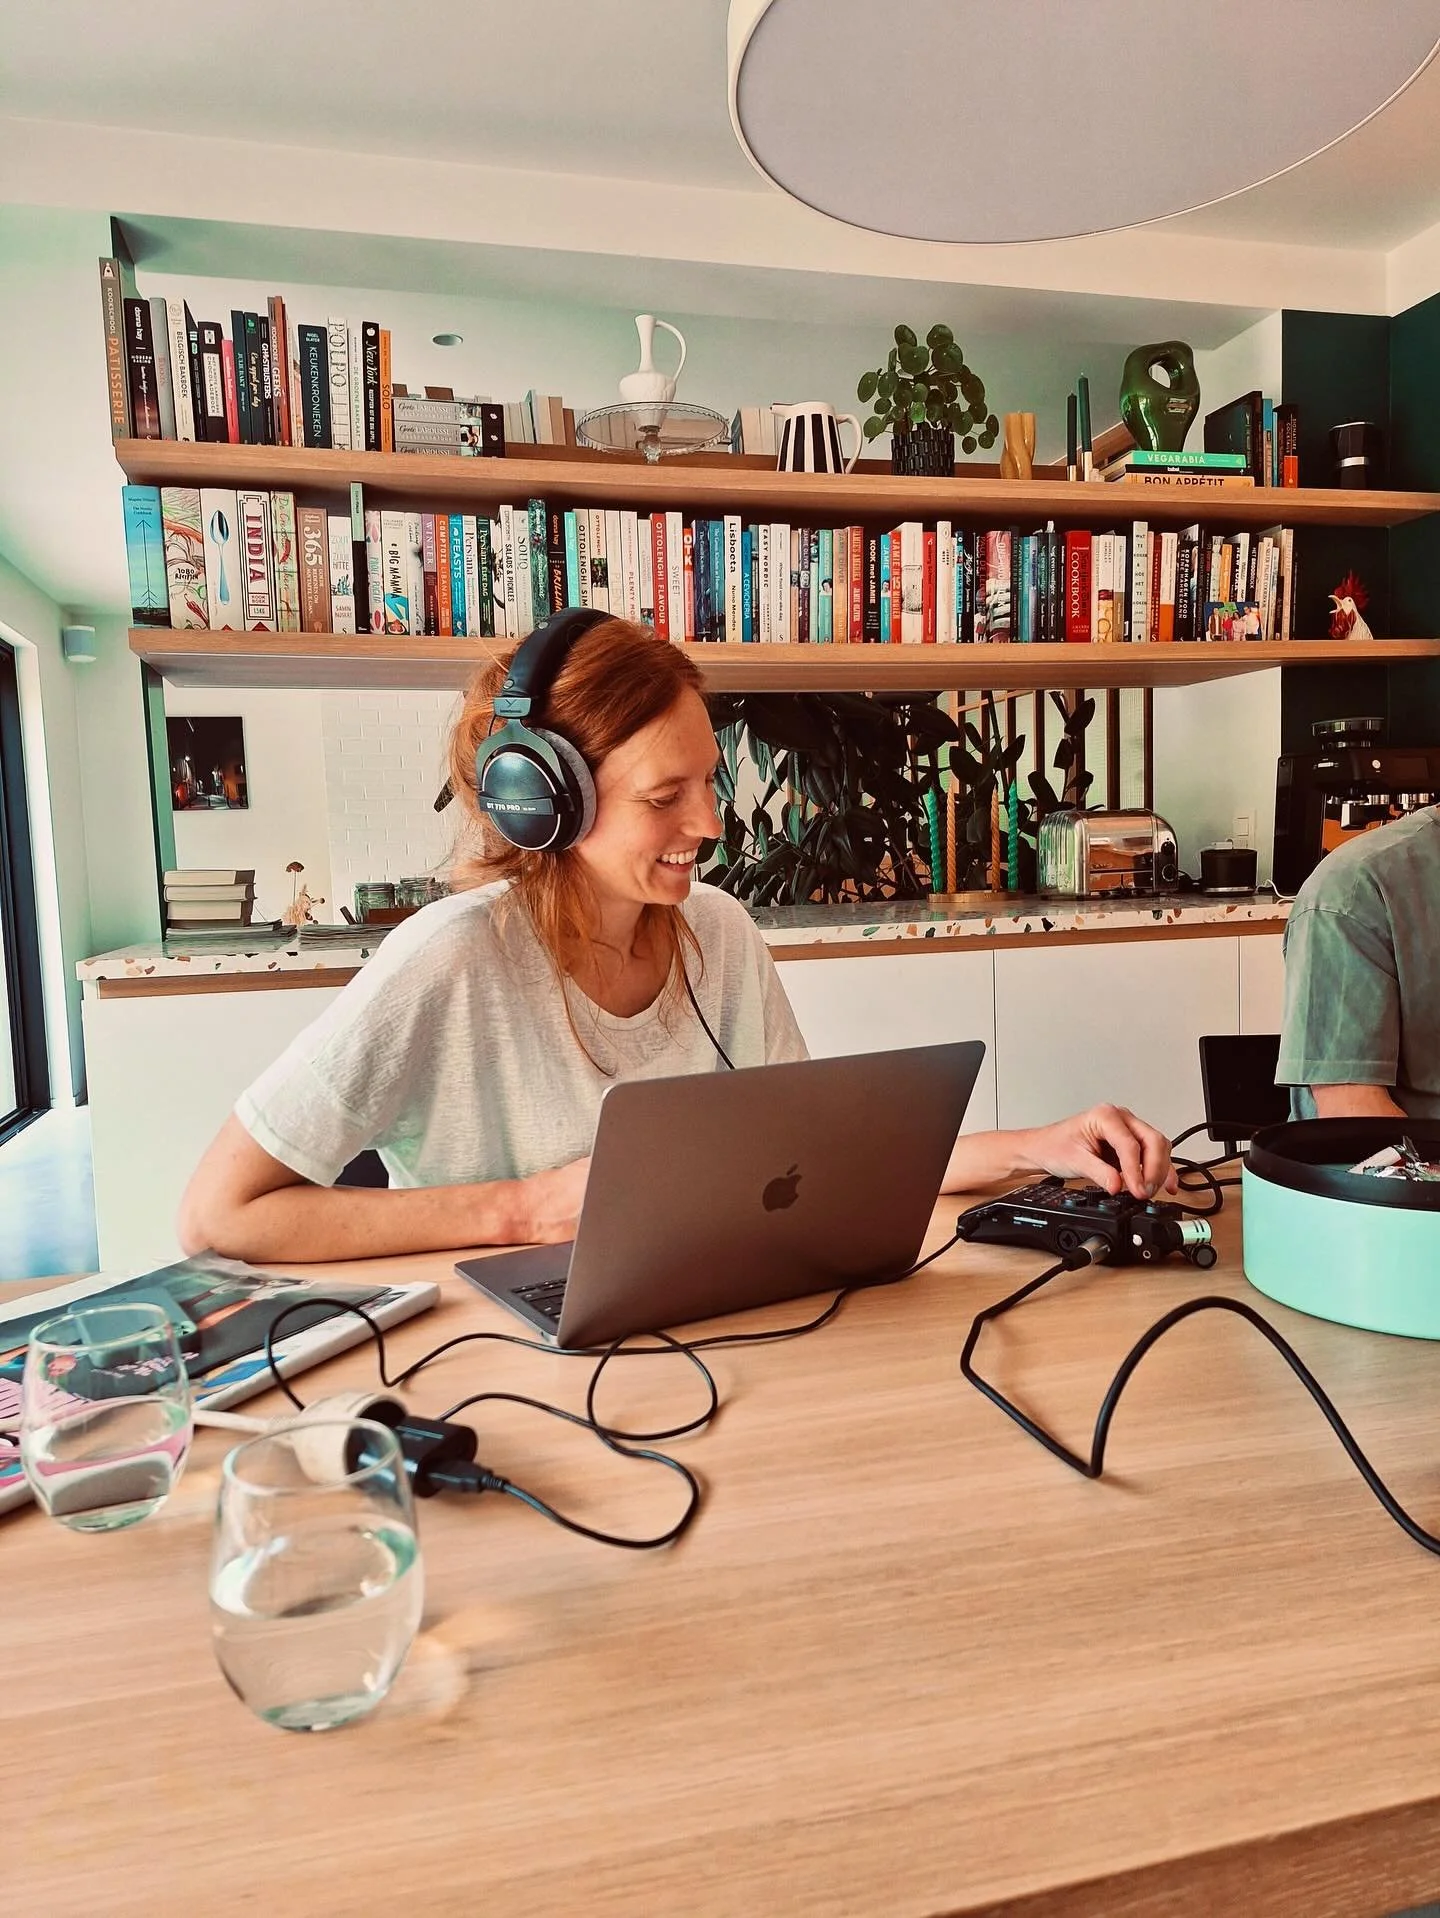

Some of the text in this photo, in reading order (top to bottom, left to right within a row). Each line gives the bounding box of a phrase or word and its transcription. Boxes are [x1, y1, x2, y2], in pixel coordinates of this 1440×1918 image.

[135, 328, 143, 340] hay
[328, 322, 346, 387] POLPO
[107, 288, 124, 424] KOOKSCHOOL PATISSERIE
[366, 341, 377, 386] New York
[273, 367, 281, 397] GEEKS
[309, 347, 321, 437] KEUKENKRONIEKEN
[382, 384, 390, 410] SOLO
[1147, 454, 1205, 464] VEGARABIA
[246, 515, 265, 583] INDIA
[304, 526, 322, 566] 365
[426, 520, 434, 565] WINTER
[453, 538, 461, 578] FEASTS
[465, 532, 474, 575] Persiana
[480, 530, 489, 566] Persiana
[517, 536, 528, 570] SOUQ
[578, 525, 588, 585] OTTOLENGHI
[684, 534, 693, 566] OTK
[729, 522, 737, 573] Lisboeta
[389, 550, 402, 598] BIG MAMMA
[656, 522, 666, 624] OTTOLENGHI FLAVOUR
[672, 566, 680, 596] SWEET
[1071, 552, 1079, 618] COOKBOOK
[743, 580, 751, 619] CEVICHERIA
